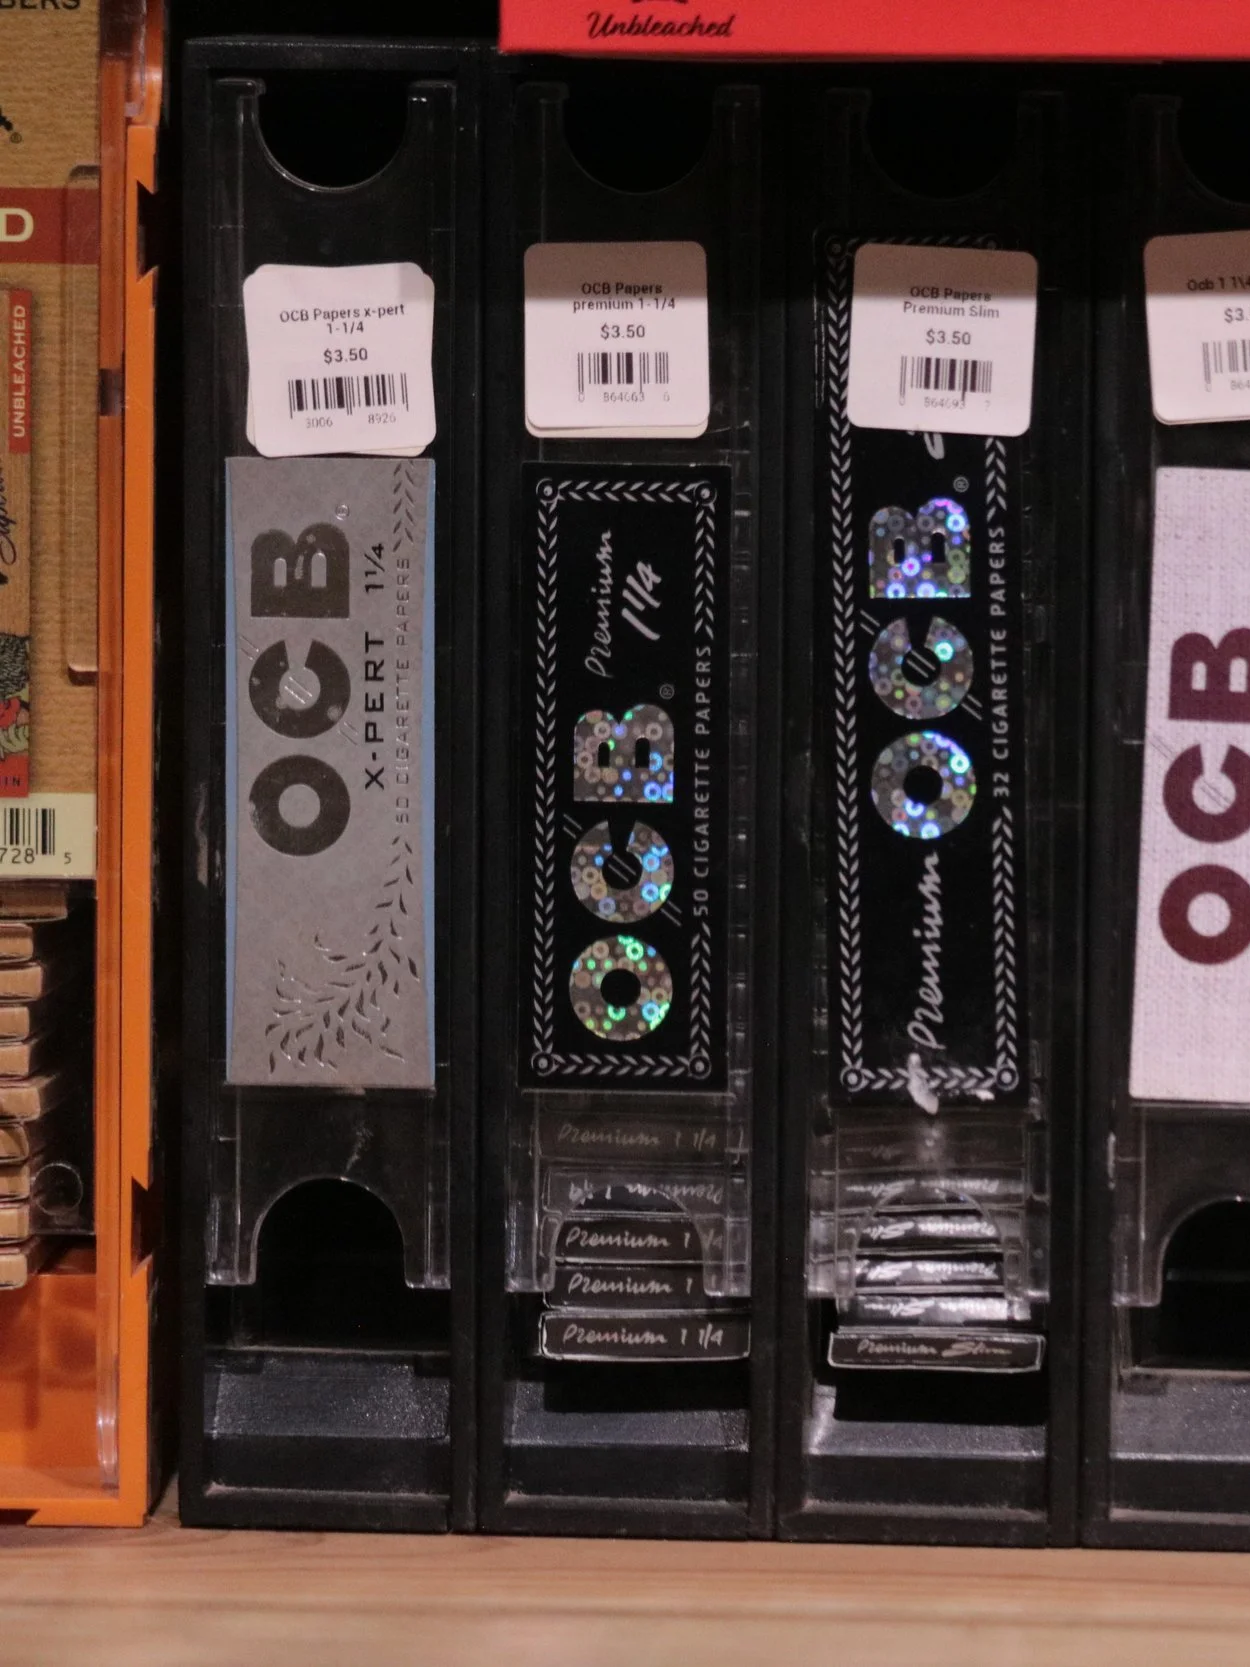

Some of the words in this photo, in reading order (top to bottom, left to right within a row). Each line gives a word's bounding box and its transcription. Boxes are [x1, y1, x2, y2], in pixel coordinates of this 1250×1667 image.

[586, 11, 736, 39] Unbleached
[581, 282, 611, 295] OCB
[615, 282, 663, 297] Papers
[910, 285, 940, 299] OCB
[944, 287, 992, 302] Papers
[279, 310, 309, 323] OCB
[313, 307, 361, 322] Papers
[364, 303, 405, 317] x-pert
[573, 298, 634, 314] premium
[638, 297, 676, 311] 1-1/4
[902, 301, 965, 317] Premium
[969, 304, 1000, 319] Slim
[326, 321, 365, 335] 1-1/4
[600, 323, 646, 340] $3.50
[925, 328, 971, 346] $3.50
[323, 347, 369, 365] $3.50
[12, 304, 27, 438] UNBLEACHED
[987, 526, 1007, 617] PAPERS
[396, 557, 410, 646] PAPERS
[584, 529, 614, 679] Premium
[868, 498, 977, 840] OCB
[249, 521, 351, 857] OCB
[695, 645, 712, 736] PAPERS
[989, 629, 1009, 760] CIGARETTE
[364, 630, 385, 791] X-PERT
[396, 659, 410, 785] CIGARETTE
[992, 772, 1010, 797] 32
[693, 748, 711, 878] CIGARETTE
[569, 703, 675, 1042] OCB
[693, 889, 710, 917] 50
[907, 851, 947, 1051] Premium
[557, 1123, 661, 1147] Premium
[565, 1226, 671, 1248] Premium
[567, 1273, 673, 1294] Premium
[562, 1323, 667, 1345] Premium
